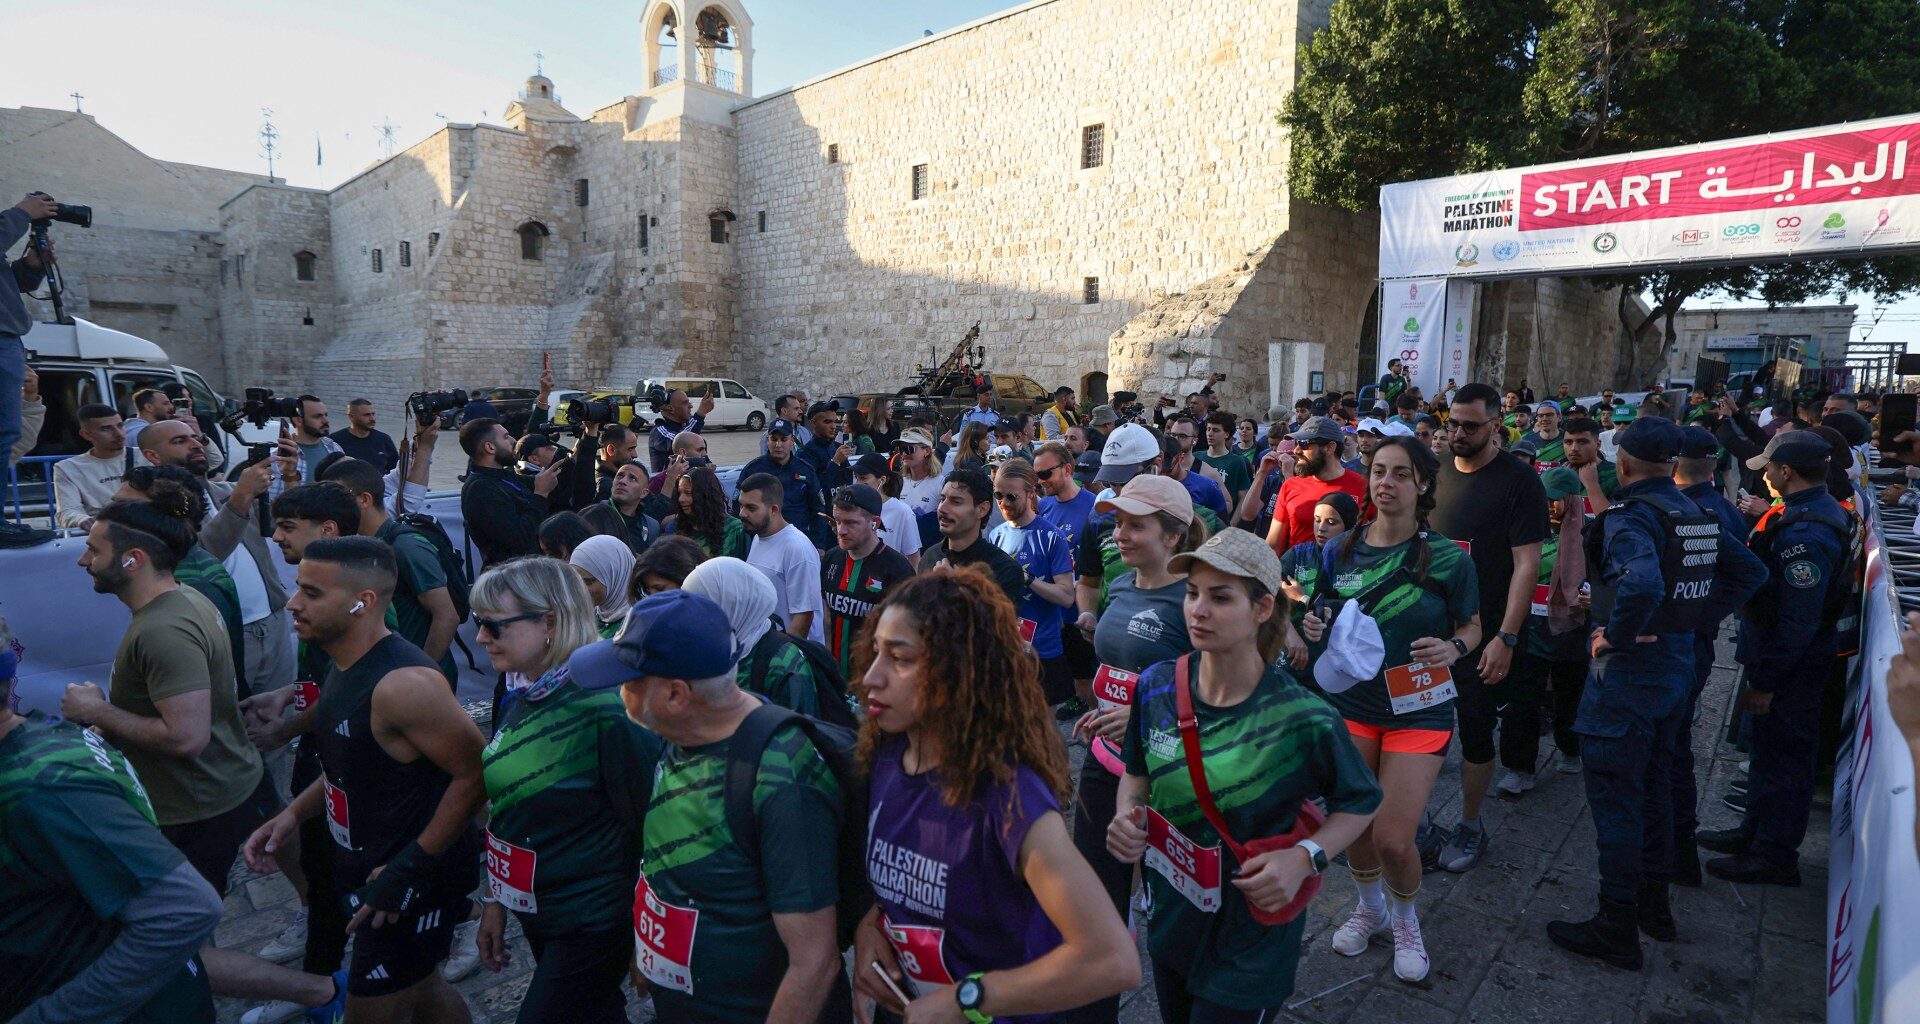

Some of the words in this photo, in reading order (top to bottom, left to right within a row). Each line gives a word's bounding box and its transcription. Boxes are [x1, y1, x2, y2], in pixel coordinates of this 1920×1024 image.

[1445, 194, 1471, 202] FREEDOM
[1482, 189, 1514, 198] MOVEMENT
[1533, 170, 1682, 217] START
[1444, 199, 1514, 218] PALESTINE
[1443, 215, 1513, 233] MARATHON
[1723, 223, 1760, 236] bpc
[1780, 543, 1807, 560] POLICE
[1129, 620, 1141, 628] BIG
[1140, 622, 1163, 636] BLUE
[1411, 672, 1433, 689] 78
[1105, 682, 1128, 702] 426
[1420, 691, 1433, 702] 42
[487, 850, 511, 878] 613
[872, 838, 949, 887] PALESTINE
[1165, 837, 1196, 874] 653
[491, 878, 502, 895] 21
[869, 859, 946, 911] MARATHON
[1172, 867, 1185, 888] 21
[894, 893, 905, 905] OF
[905, 896, 944, 920] MOVEMENT
[640, 910, 666, 949] 612
[642, 948, 654, 970] 21
